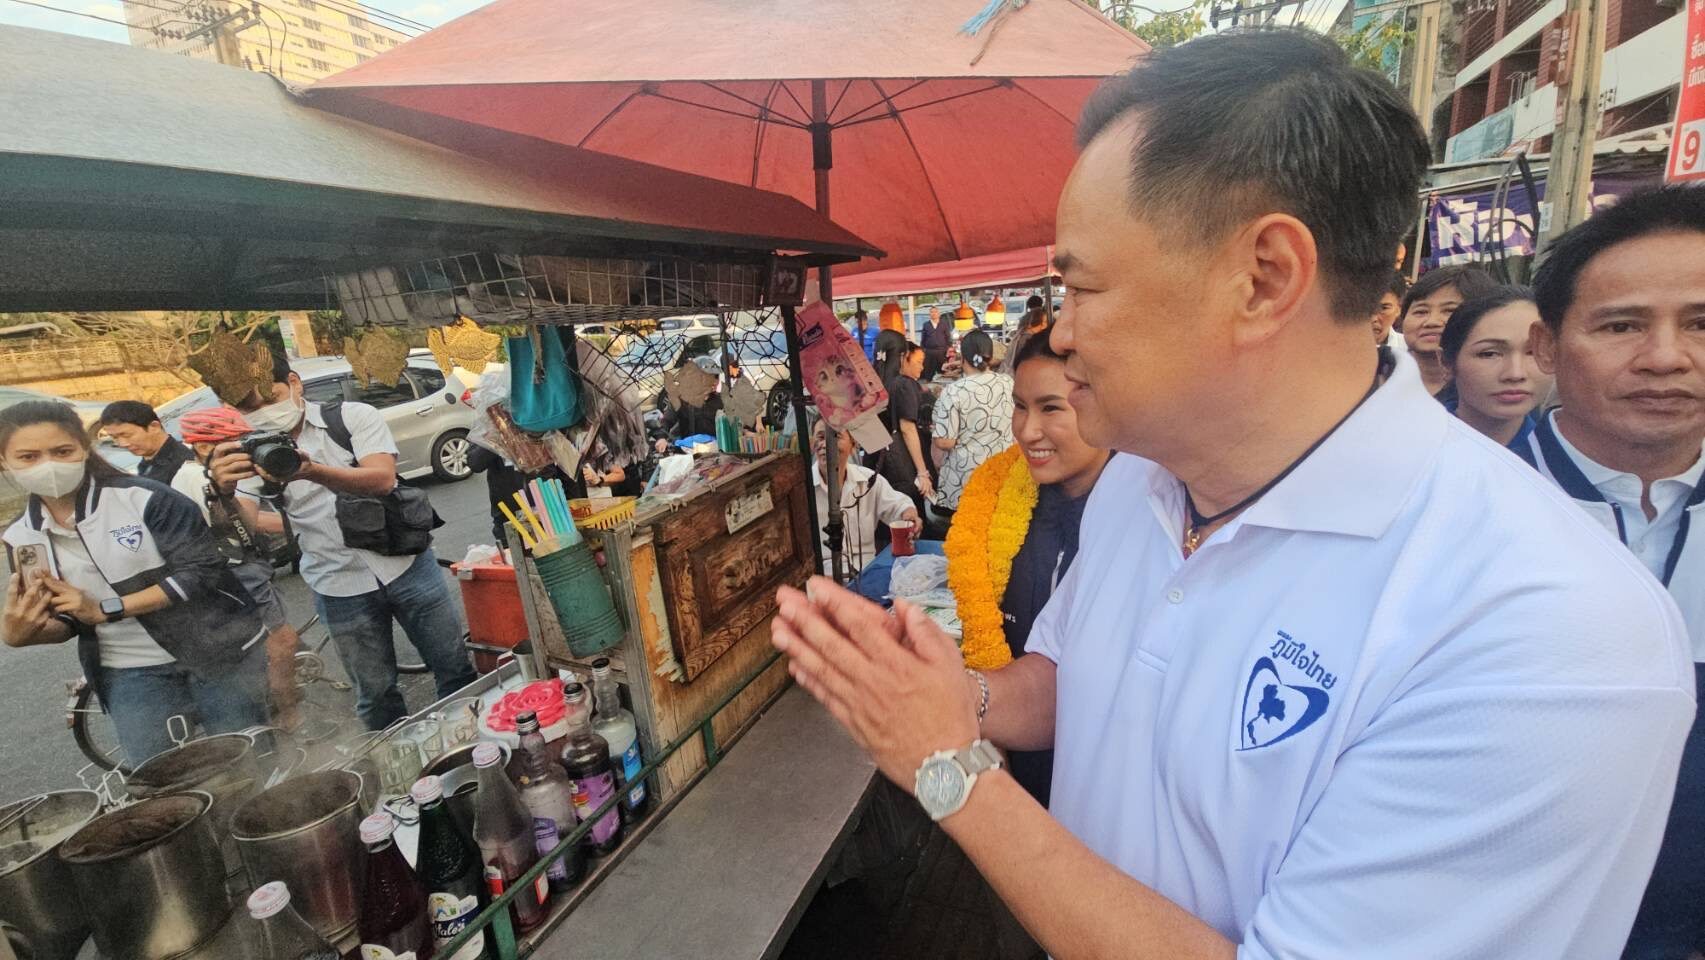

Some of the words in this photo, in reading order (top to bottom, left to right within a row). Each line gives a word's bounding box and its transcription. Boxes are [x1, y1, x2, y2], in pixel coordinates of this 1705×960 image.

[233, 519, 252, 547] SONY
[1269, 638, 1338, 690] ภูมิใจไทย
